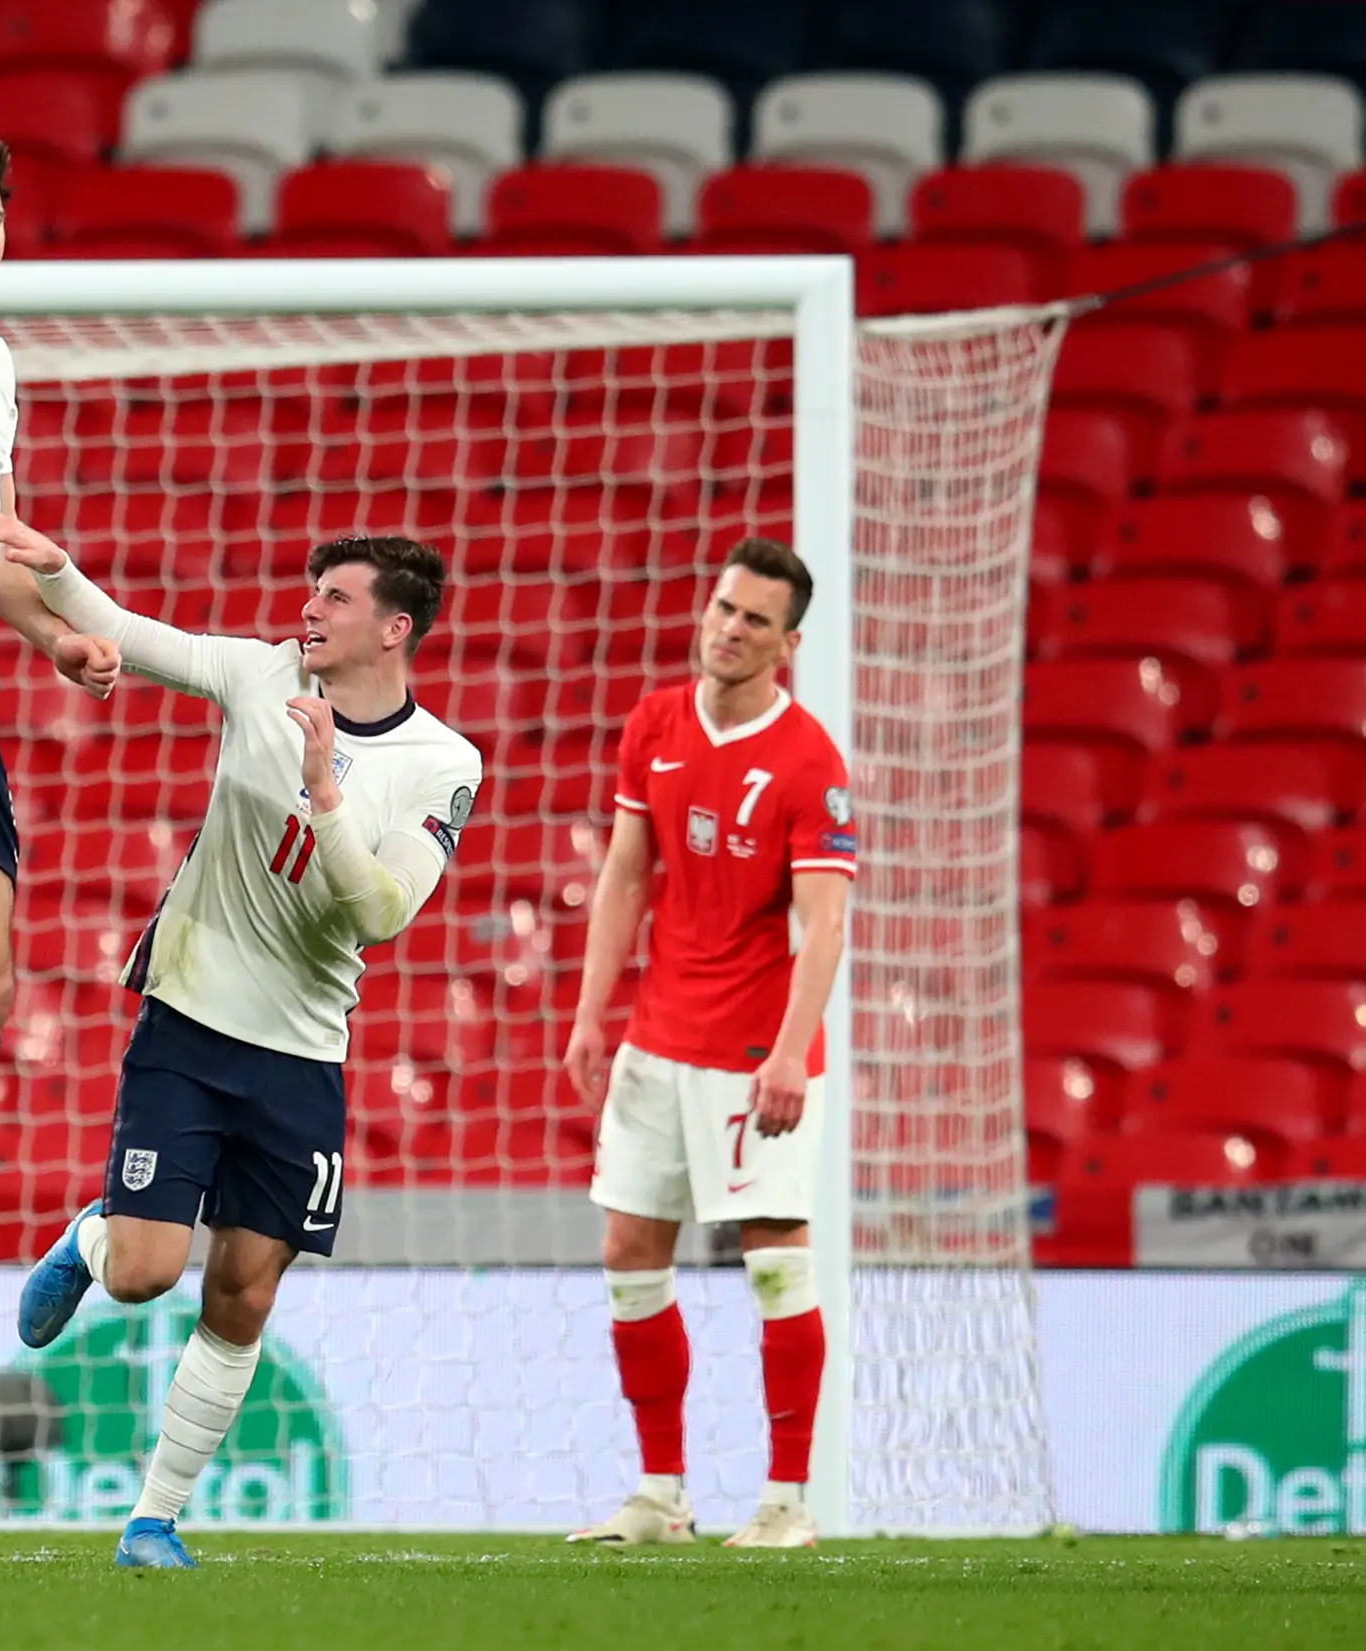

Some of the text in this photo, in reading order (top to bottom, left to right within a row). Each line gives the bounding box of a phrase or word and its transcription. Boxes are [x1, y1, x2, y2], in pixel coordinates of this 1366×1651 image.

[736, 768, 772, 827] 7
[269, 814, 316, 885] 11
[726, 1114, 747, 1169] 7
[306, 1151, 343, 1214] 11
